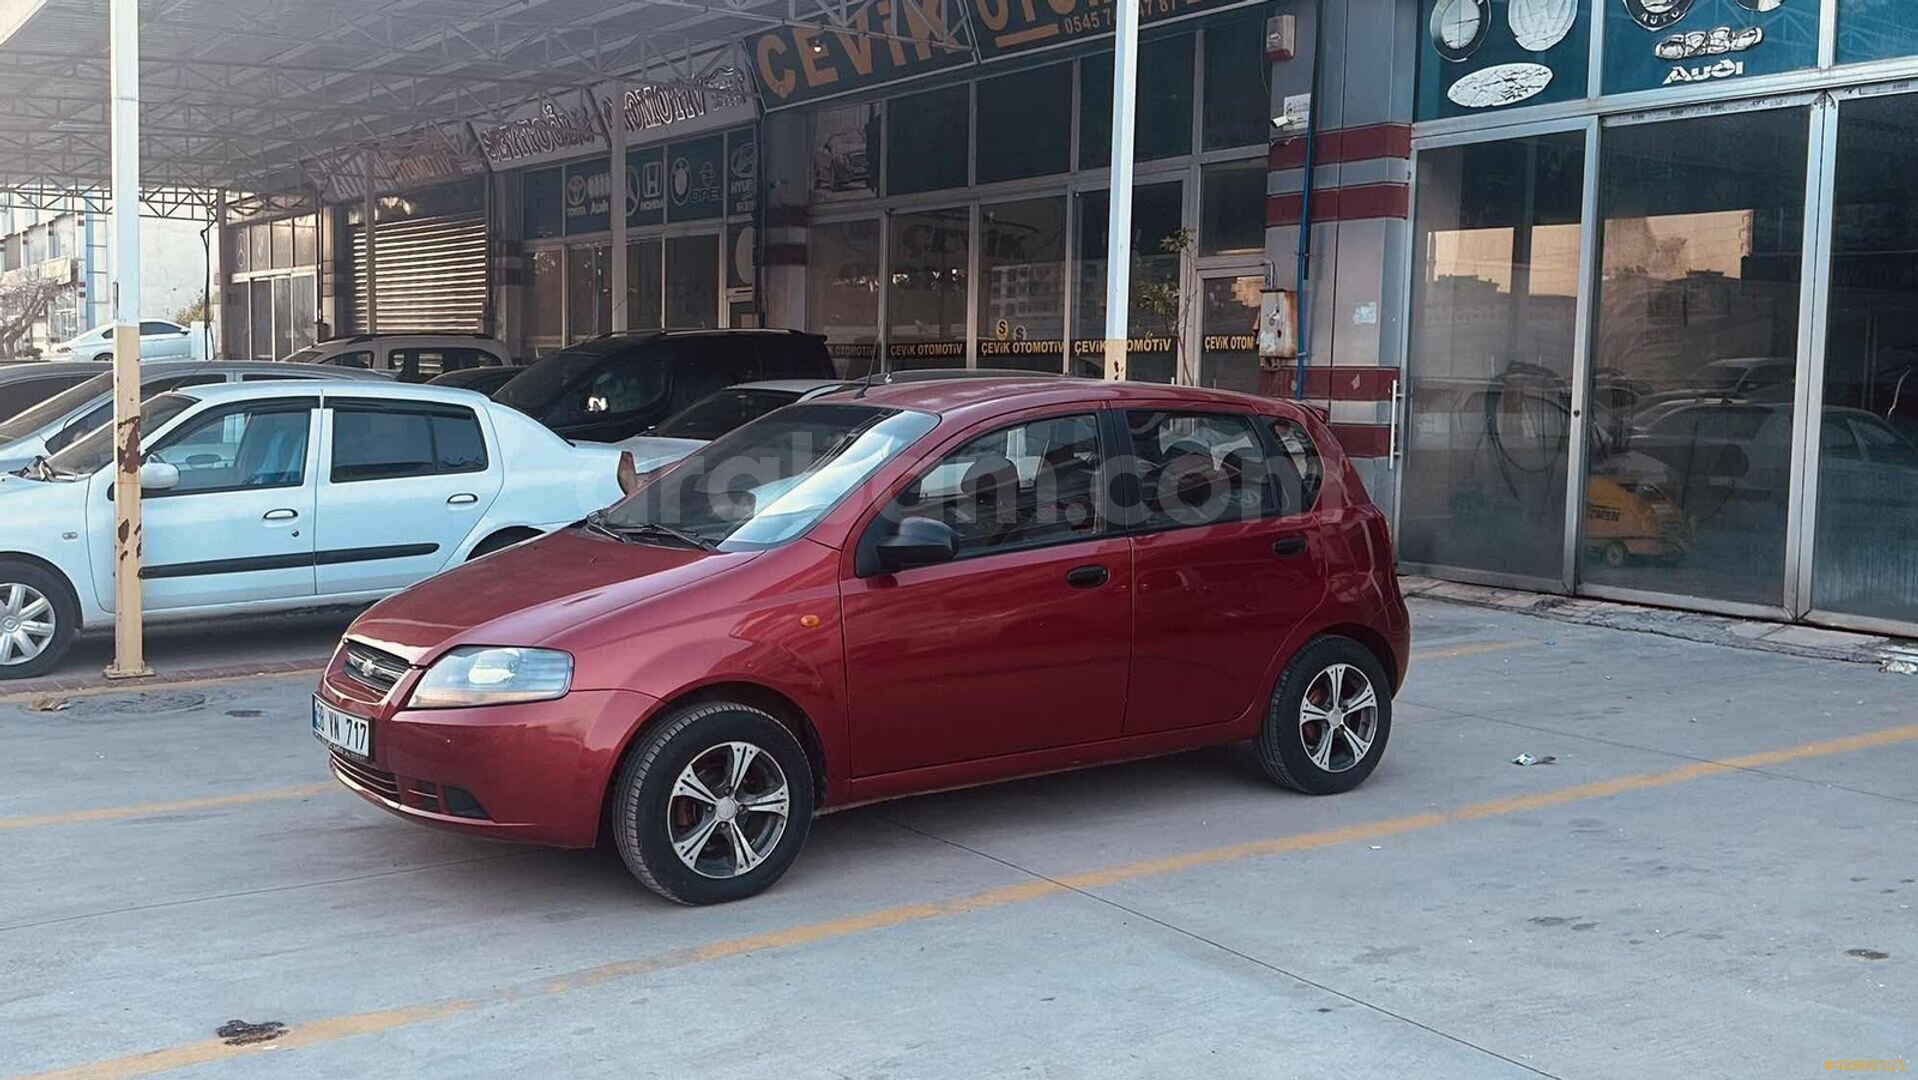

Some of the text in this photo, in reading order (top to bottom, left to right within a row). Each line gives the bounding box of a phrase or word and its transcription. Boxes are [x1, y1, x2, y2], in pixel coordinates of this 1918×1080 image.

[1064, 15, 1100, 34] 0545
[1640, 10, 1680, 25] AUTO
[346, 718, 367, 750] 717
